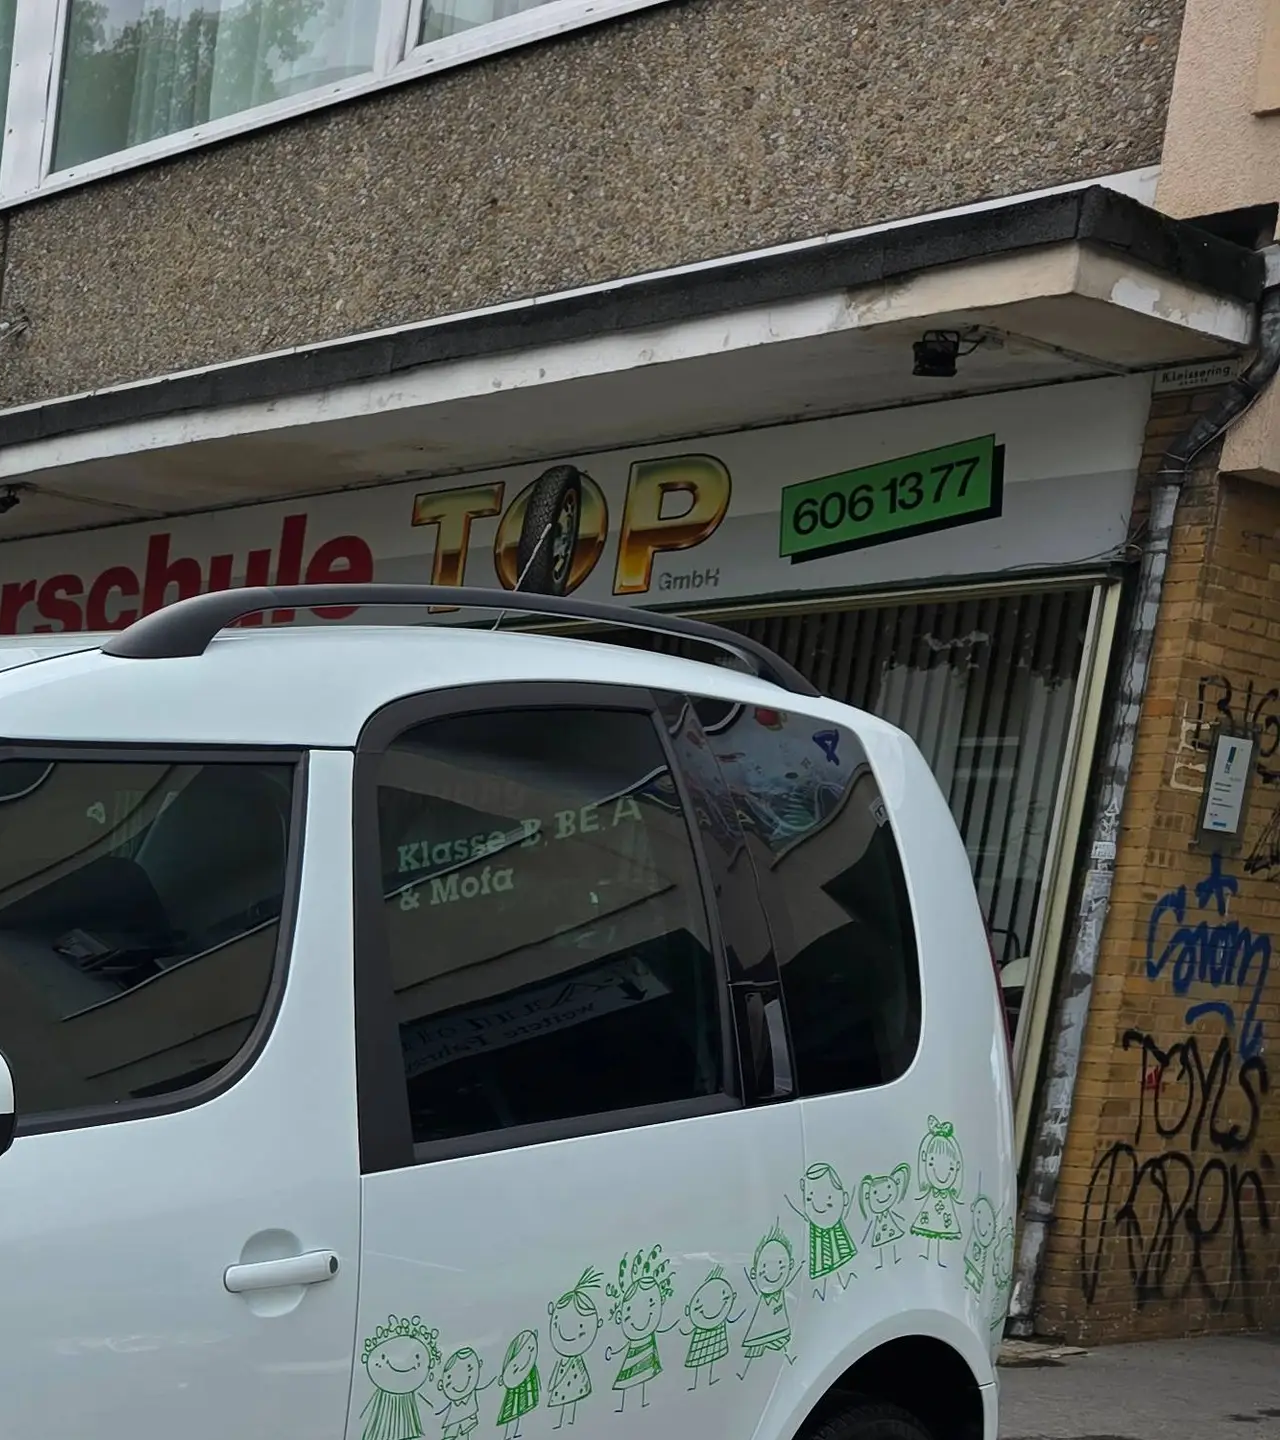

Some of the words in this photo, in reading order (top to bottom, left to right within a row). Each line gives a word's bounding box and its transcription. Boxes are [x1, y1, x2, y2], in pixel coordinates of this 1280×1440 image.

[410, 452, 733, 614] TOP
[657, 566, 721, 592] GmbH
[397, 830, 506, 872] Klasse
[612, 796, 643, 828] A
[399, 886, 420, 912] &
[430, 866, 515, 907] Mofa
